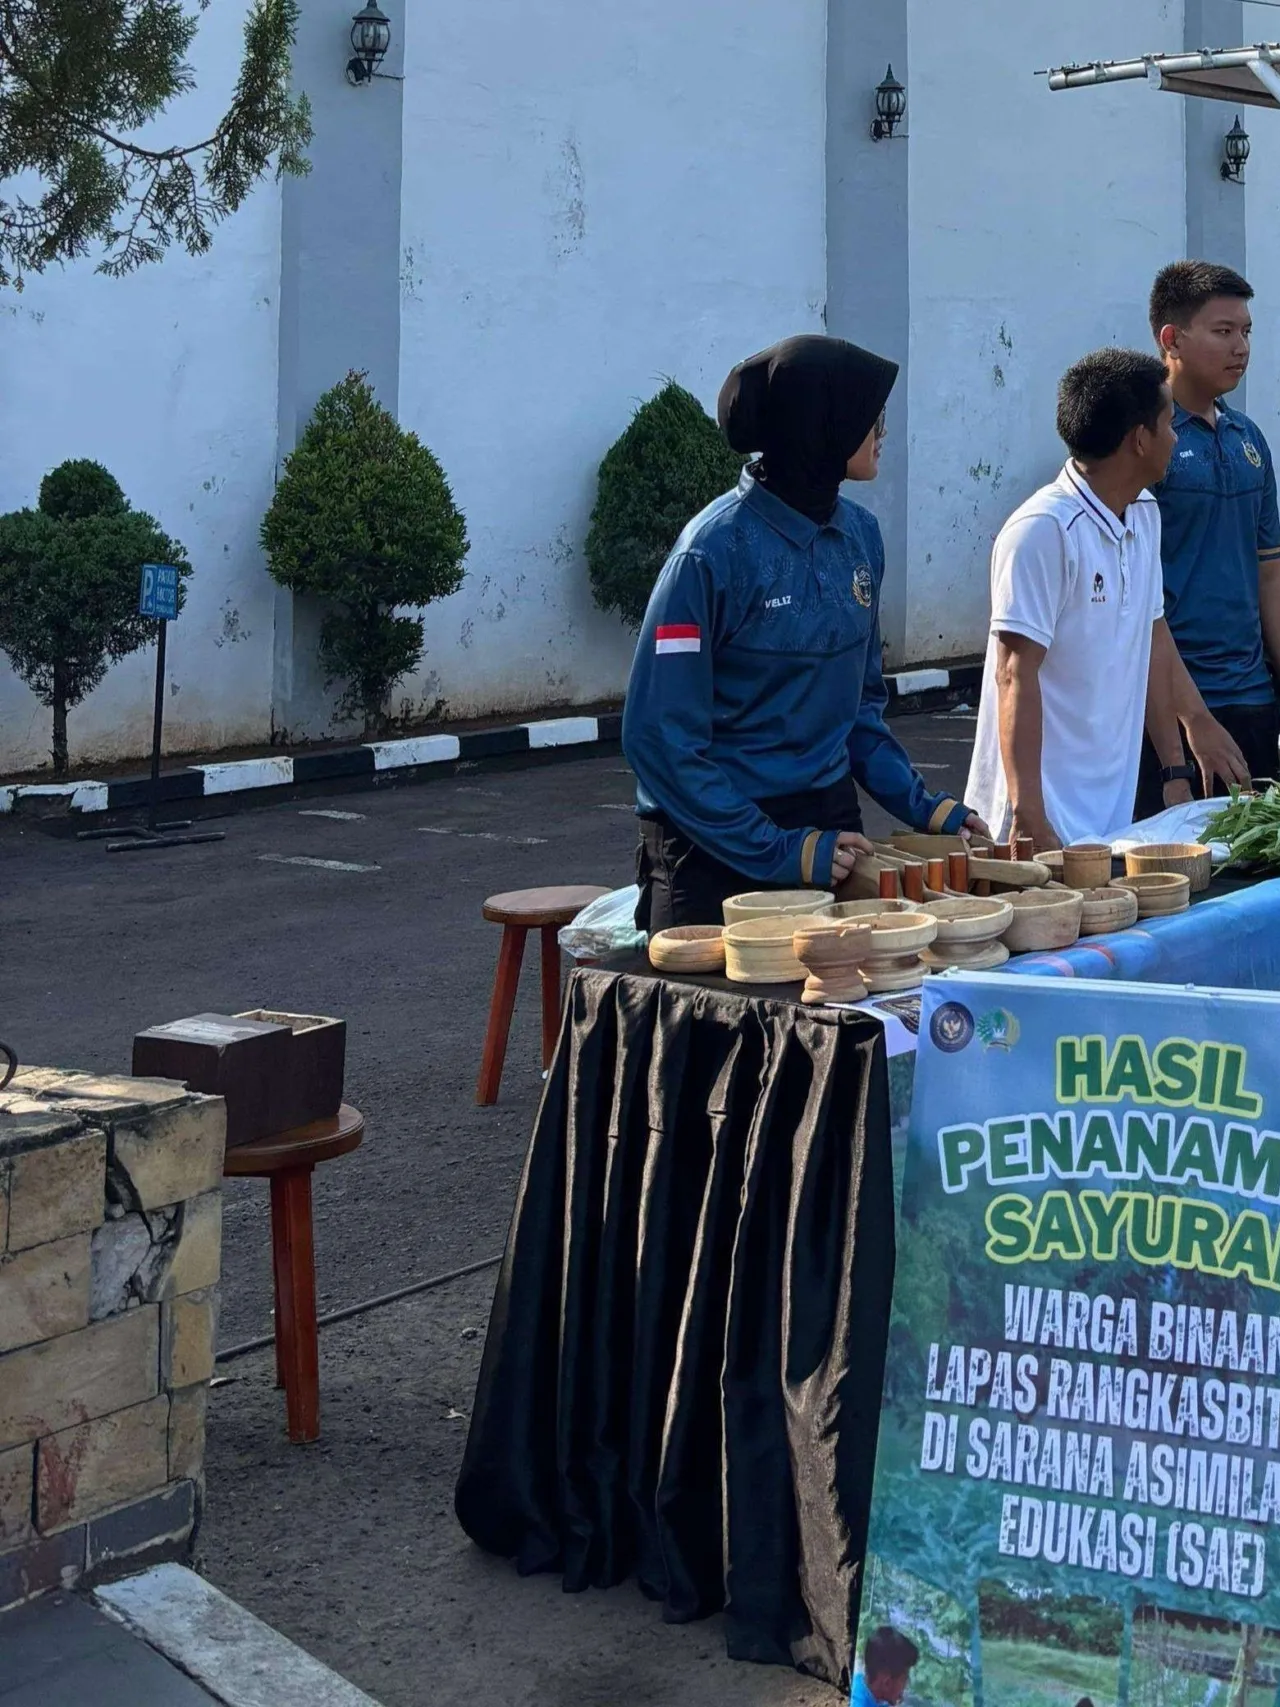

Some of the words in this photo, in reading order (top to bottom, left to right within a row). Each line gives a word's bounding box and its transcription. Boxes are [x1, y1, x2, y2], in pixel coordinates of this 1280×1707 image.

[1055, 1033, 1263, 1119] HASIL
[1004, 1283, 1138, 1358] WARGA
[925, 1342, 1039, 1414] LAPAS
[920, 1411, 959, 1473] DI
[966, 1417, 1114, 1498] SARANA
[999, 1493, 1157, 1579] EDUKASI
[1166, 1520, 1266, 1598] (SAE)
